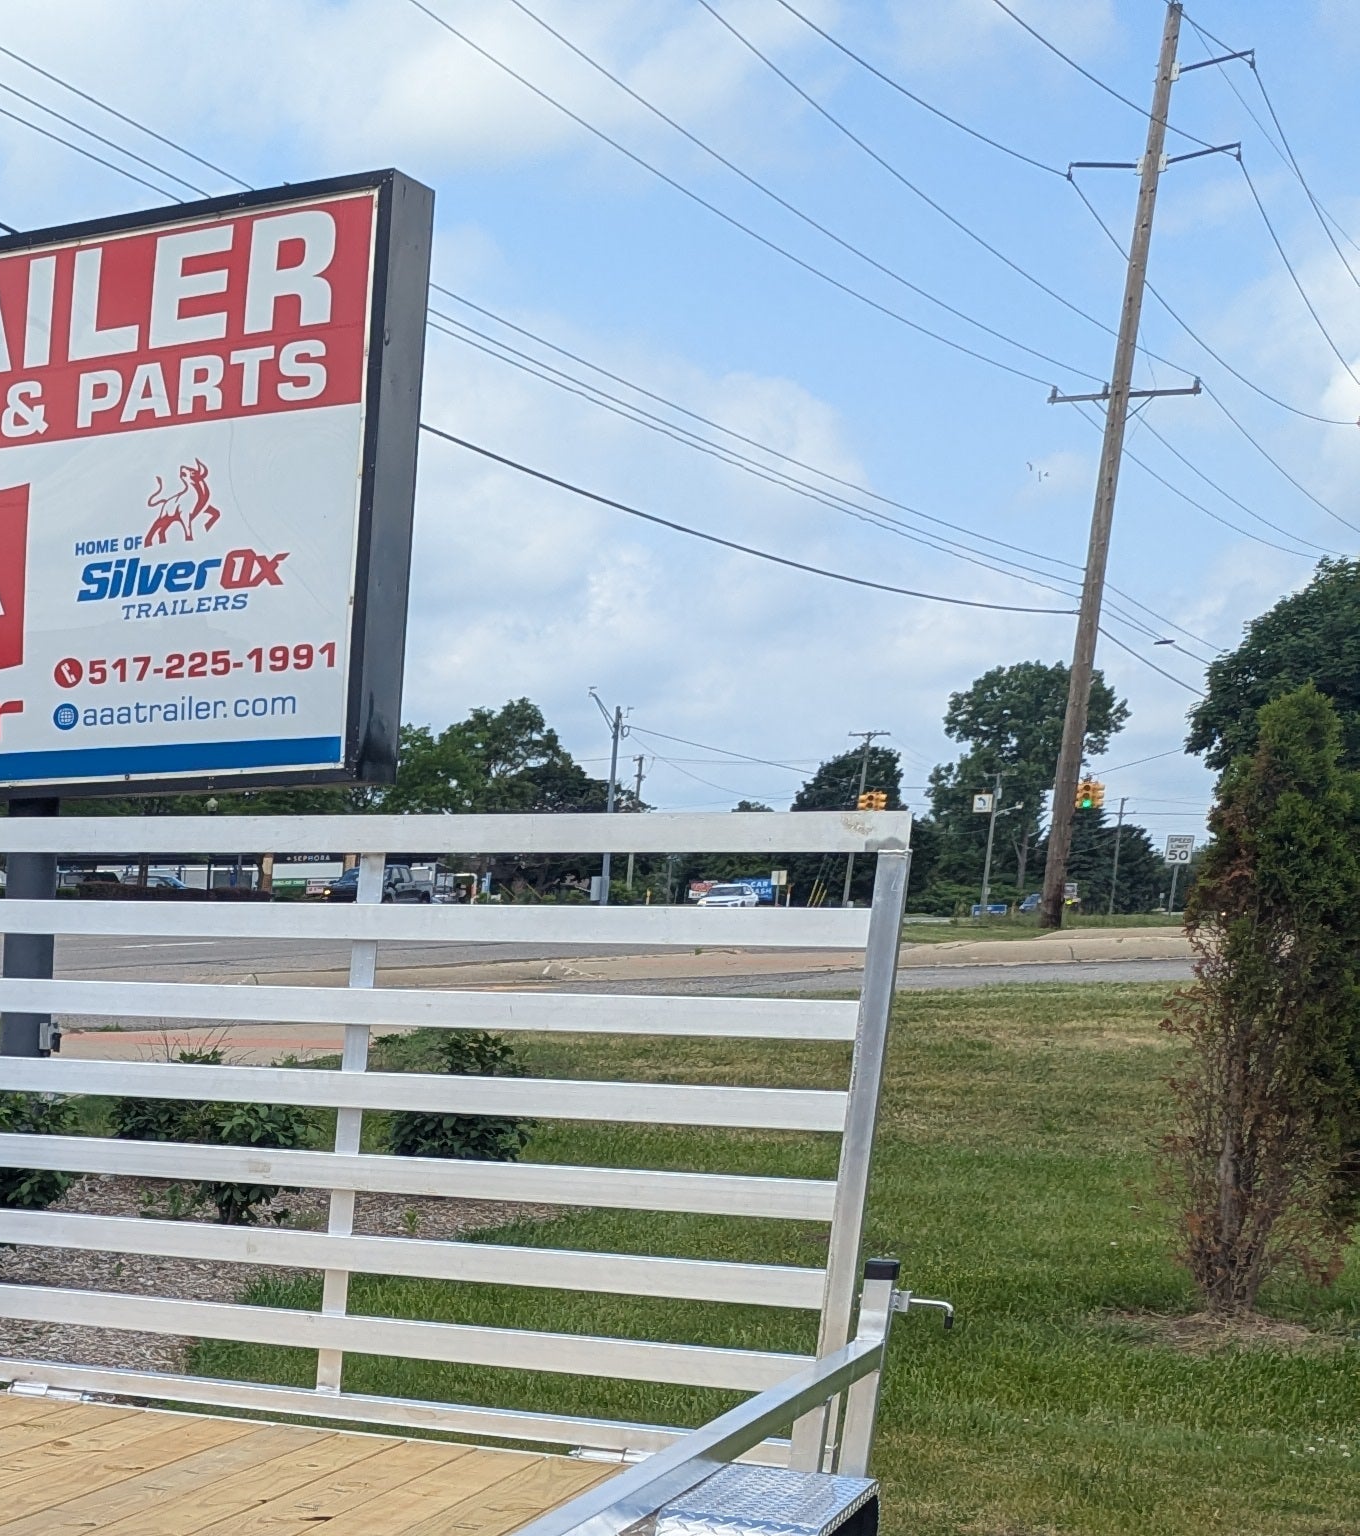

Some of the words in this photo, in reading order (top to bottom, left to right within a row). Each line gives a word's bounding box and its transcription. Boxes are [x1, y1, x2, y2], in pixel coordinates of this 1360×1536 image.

[0, 380, 49, 438] &
[76, 339, 328, 429] PARTS
[75, 538, 119, 556] HOME
[123, 535, 143, 550] OF
[121, 593, 249, 620] TRAILERS
[88, 641, 336, 685] 517-225-1991
[82, 695, 297, 727] aaatrailer.com
[293, 854, 331, 862] SEPHORA
[1168, 850, 1189, 861] 50
